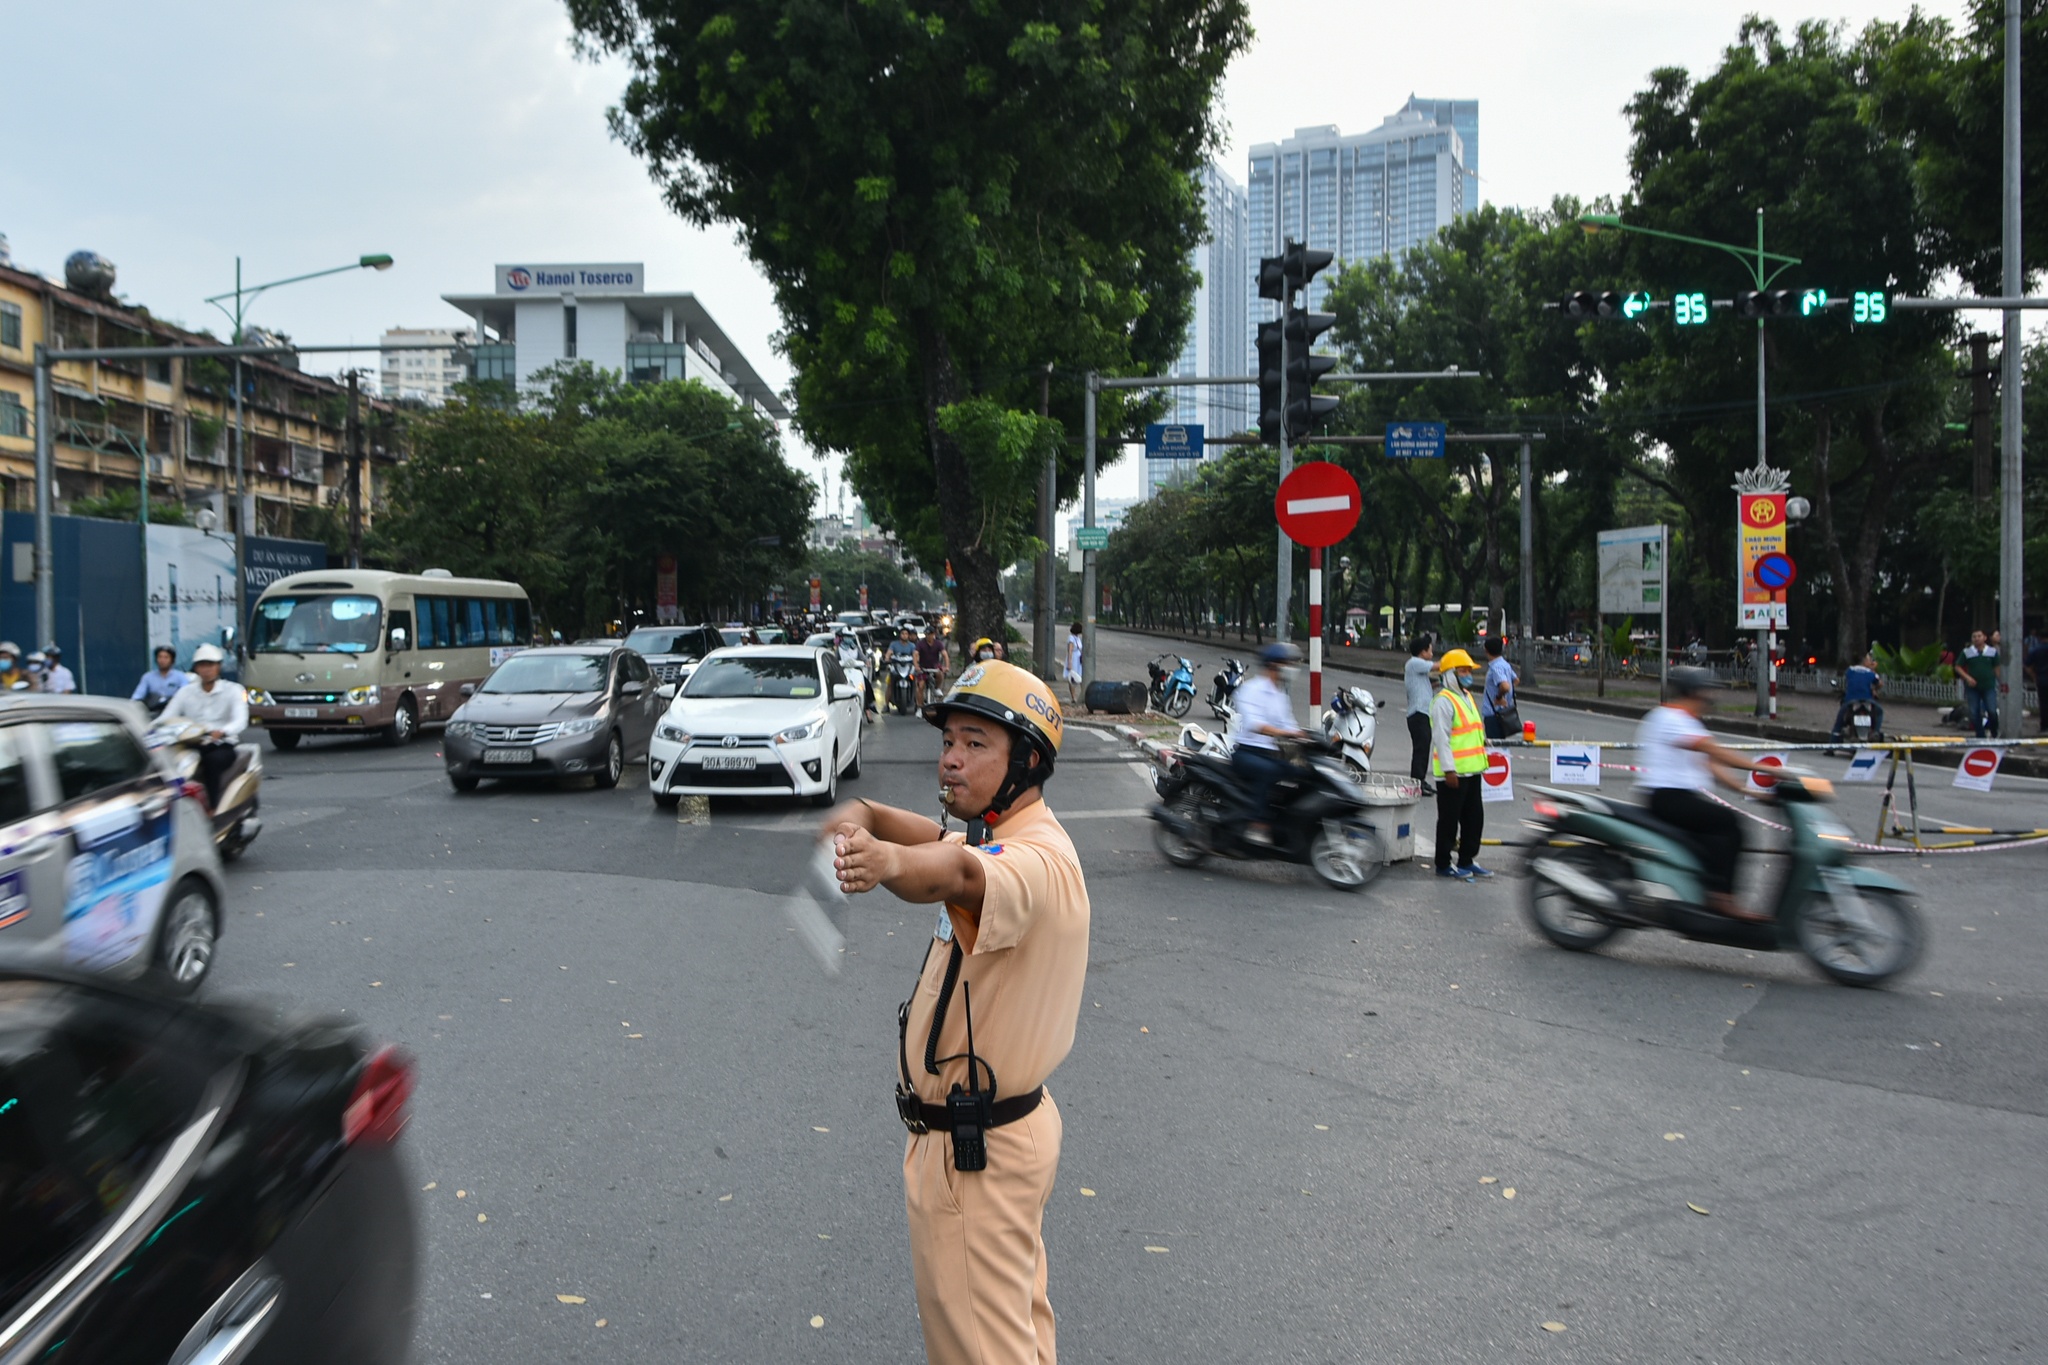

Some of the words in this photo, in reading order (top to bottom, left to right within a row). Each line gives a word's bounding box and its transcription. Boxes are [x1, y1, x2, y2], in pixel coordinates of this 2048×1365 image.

[536, 271, 575, 286] Hanoi
[579, 271, 633, 286] Toserco
[1675, 293, 1706, 325] 35
[1854, 291, 1885, 322] 35
[1025, 692, 1061, 731] CSGT
